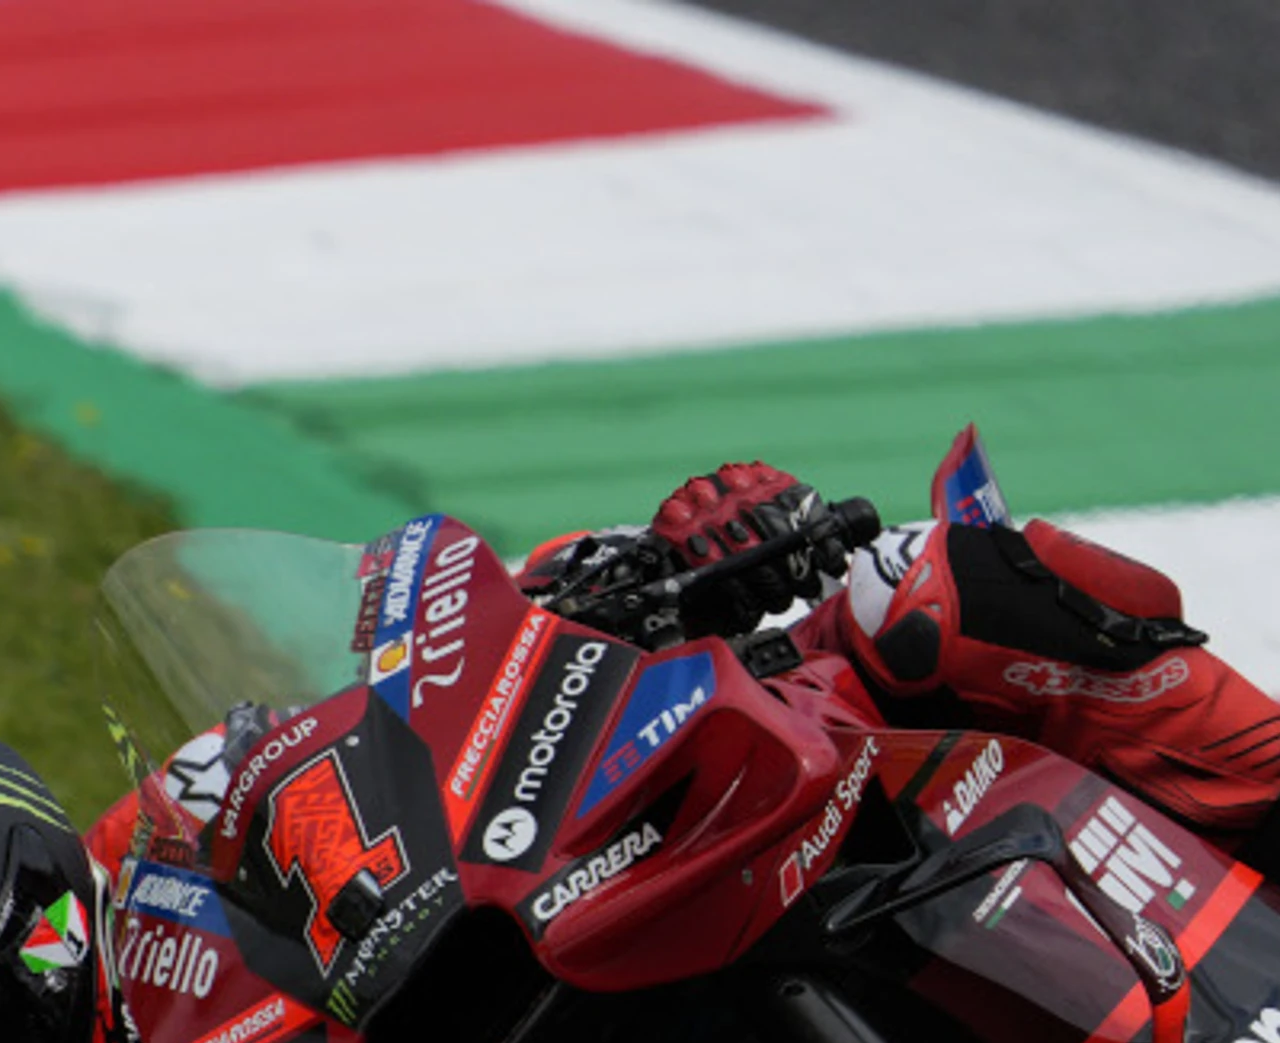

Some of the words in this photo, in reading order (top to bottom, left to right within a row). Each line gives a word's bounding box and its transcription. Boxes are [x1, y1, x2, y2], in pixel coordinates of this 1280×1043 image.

[382, 519, 432, 626] ADVANCE
[450, 612, 545, 800] FRECCIAROSSA
[515, 641, 608, 801] motorola
[637, 687, 708, 748] TIM
[263, 748, 412, 980] 1
[800, 802, 844, 870] Audi
[836, 736, 881, 807] Sport
[530, 821, 664, 922] CARRERA
